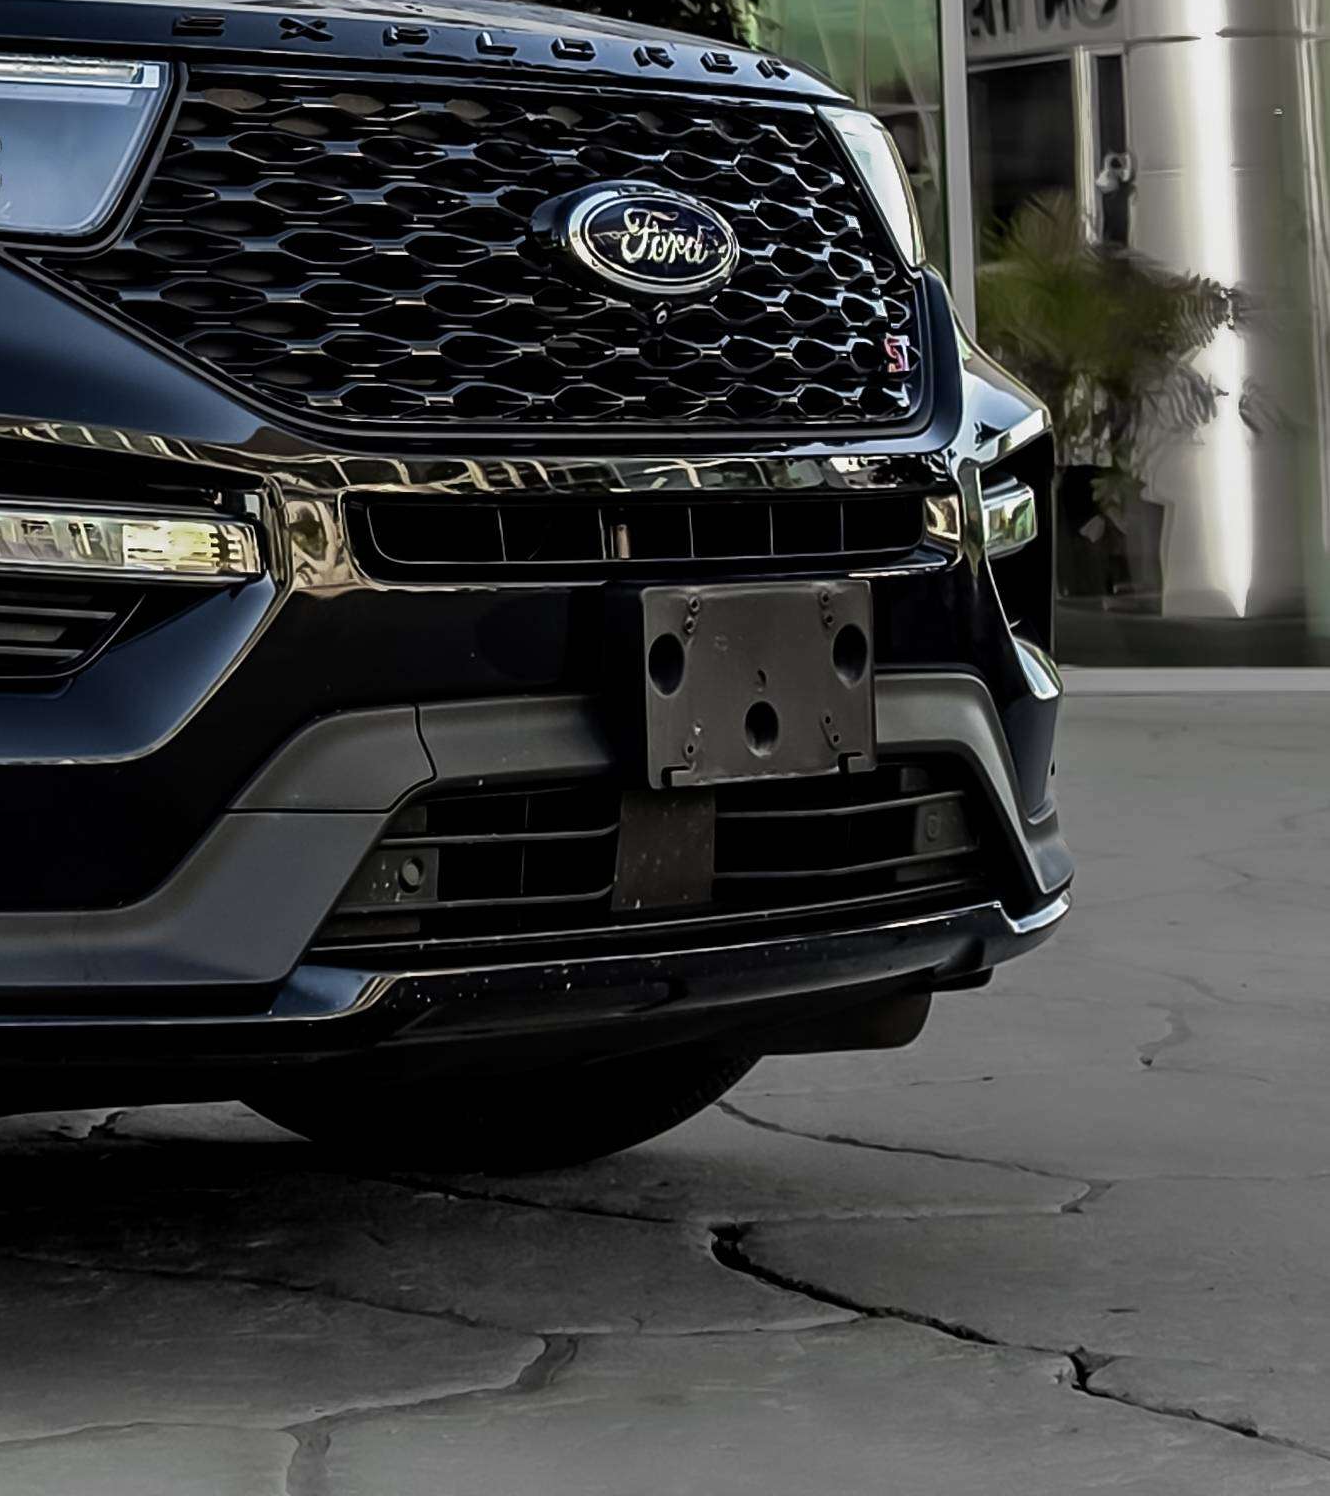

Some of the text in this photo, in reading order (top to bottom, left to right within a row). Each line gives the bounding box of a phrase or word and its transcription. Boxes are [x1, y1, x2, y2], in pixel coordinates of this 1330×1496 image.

[172, 13, 792, 80] EXPLORER
[620, 207, 714, 264] Ford
[884, 332, 910, 373] ST
